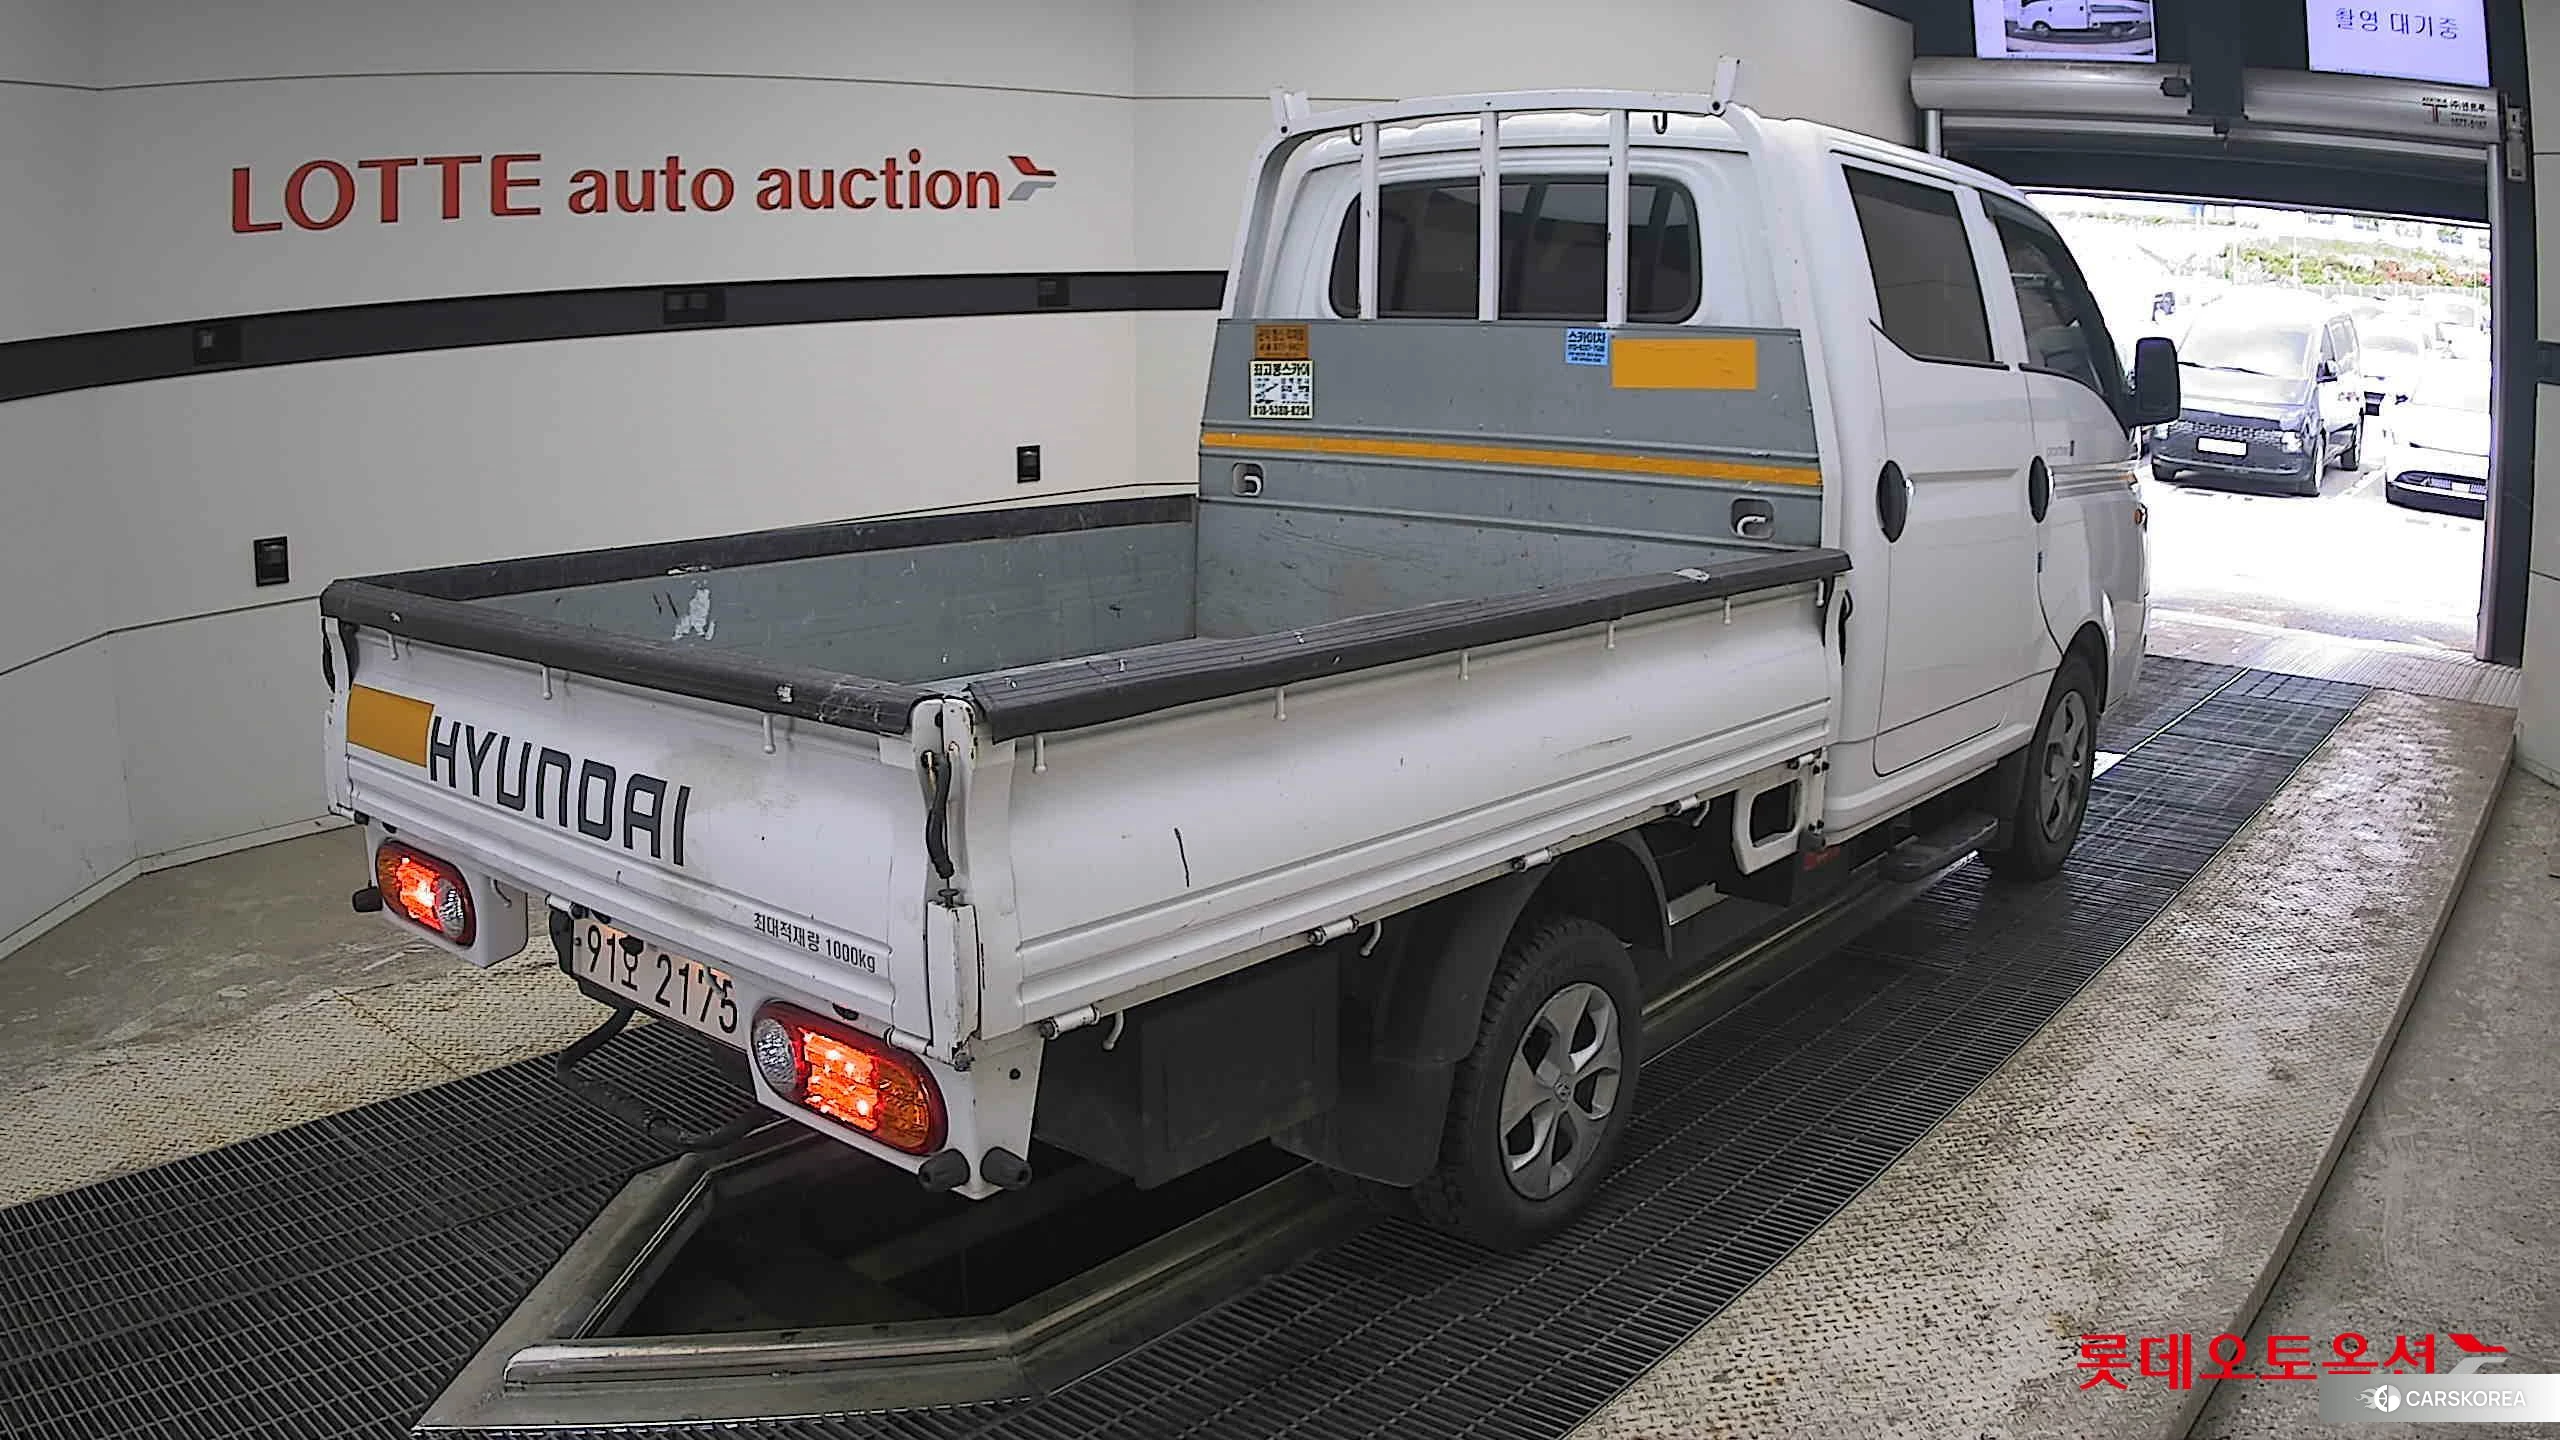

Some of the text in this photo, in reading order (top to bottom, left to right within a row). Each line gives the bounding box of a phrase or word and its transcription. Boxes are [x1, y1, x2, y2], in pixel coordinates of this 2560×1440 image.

[232, 148, 1001, 235] LOTTE auto auction
[429, 715, 692, 867] HYUNDAI
[753, 911, 876, 974] 최대적재량 1000kg
[654, 953, 738, 1034] 2175
